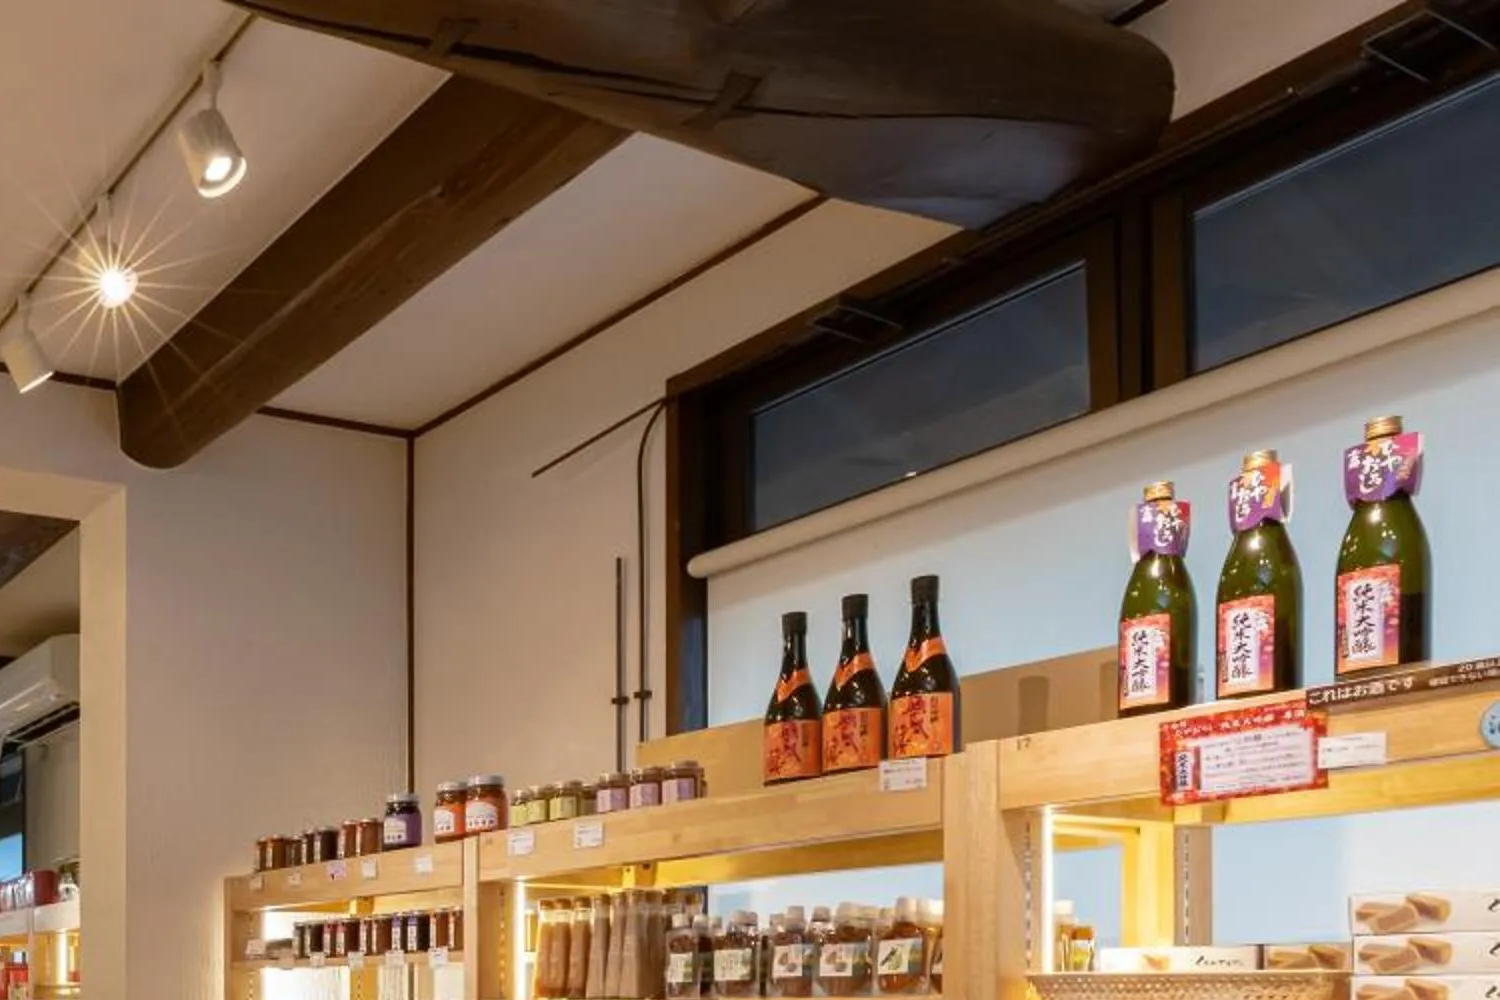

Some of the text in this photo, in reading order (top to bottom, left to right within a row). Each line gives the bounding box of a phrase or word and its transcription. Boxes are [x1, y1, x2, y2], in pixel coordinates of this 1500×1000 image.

[1231, 612, 1253, 679] 純米大吟醸
[1353, 583, 1377, 654] 純米大吟醸
[1131, 630, 1151, 693] 純米大吟醸
[1308, 676, 1415, 705] これはお酒です
